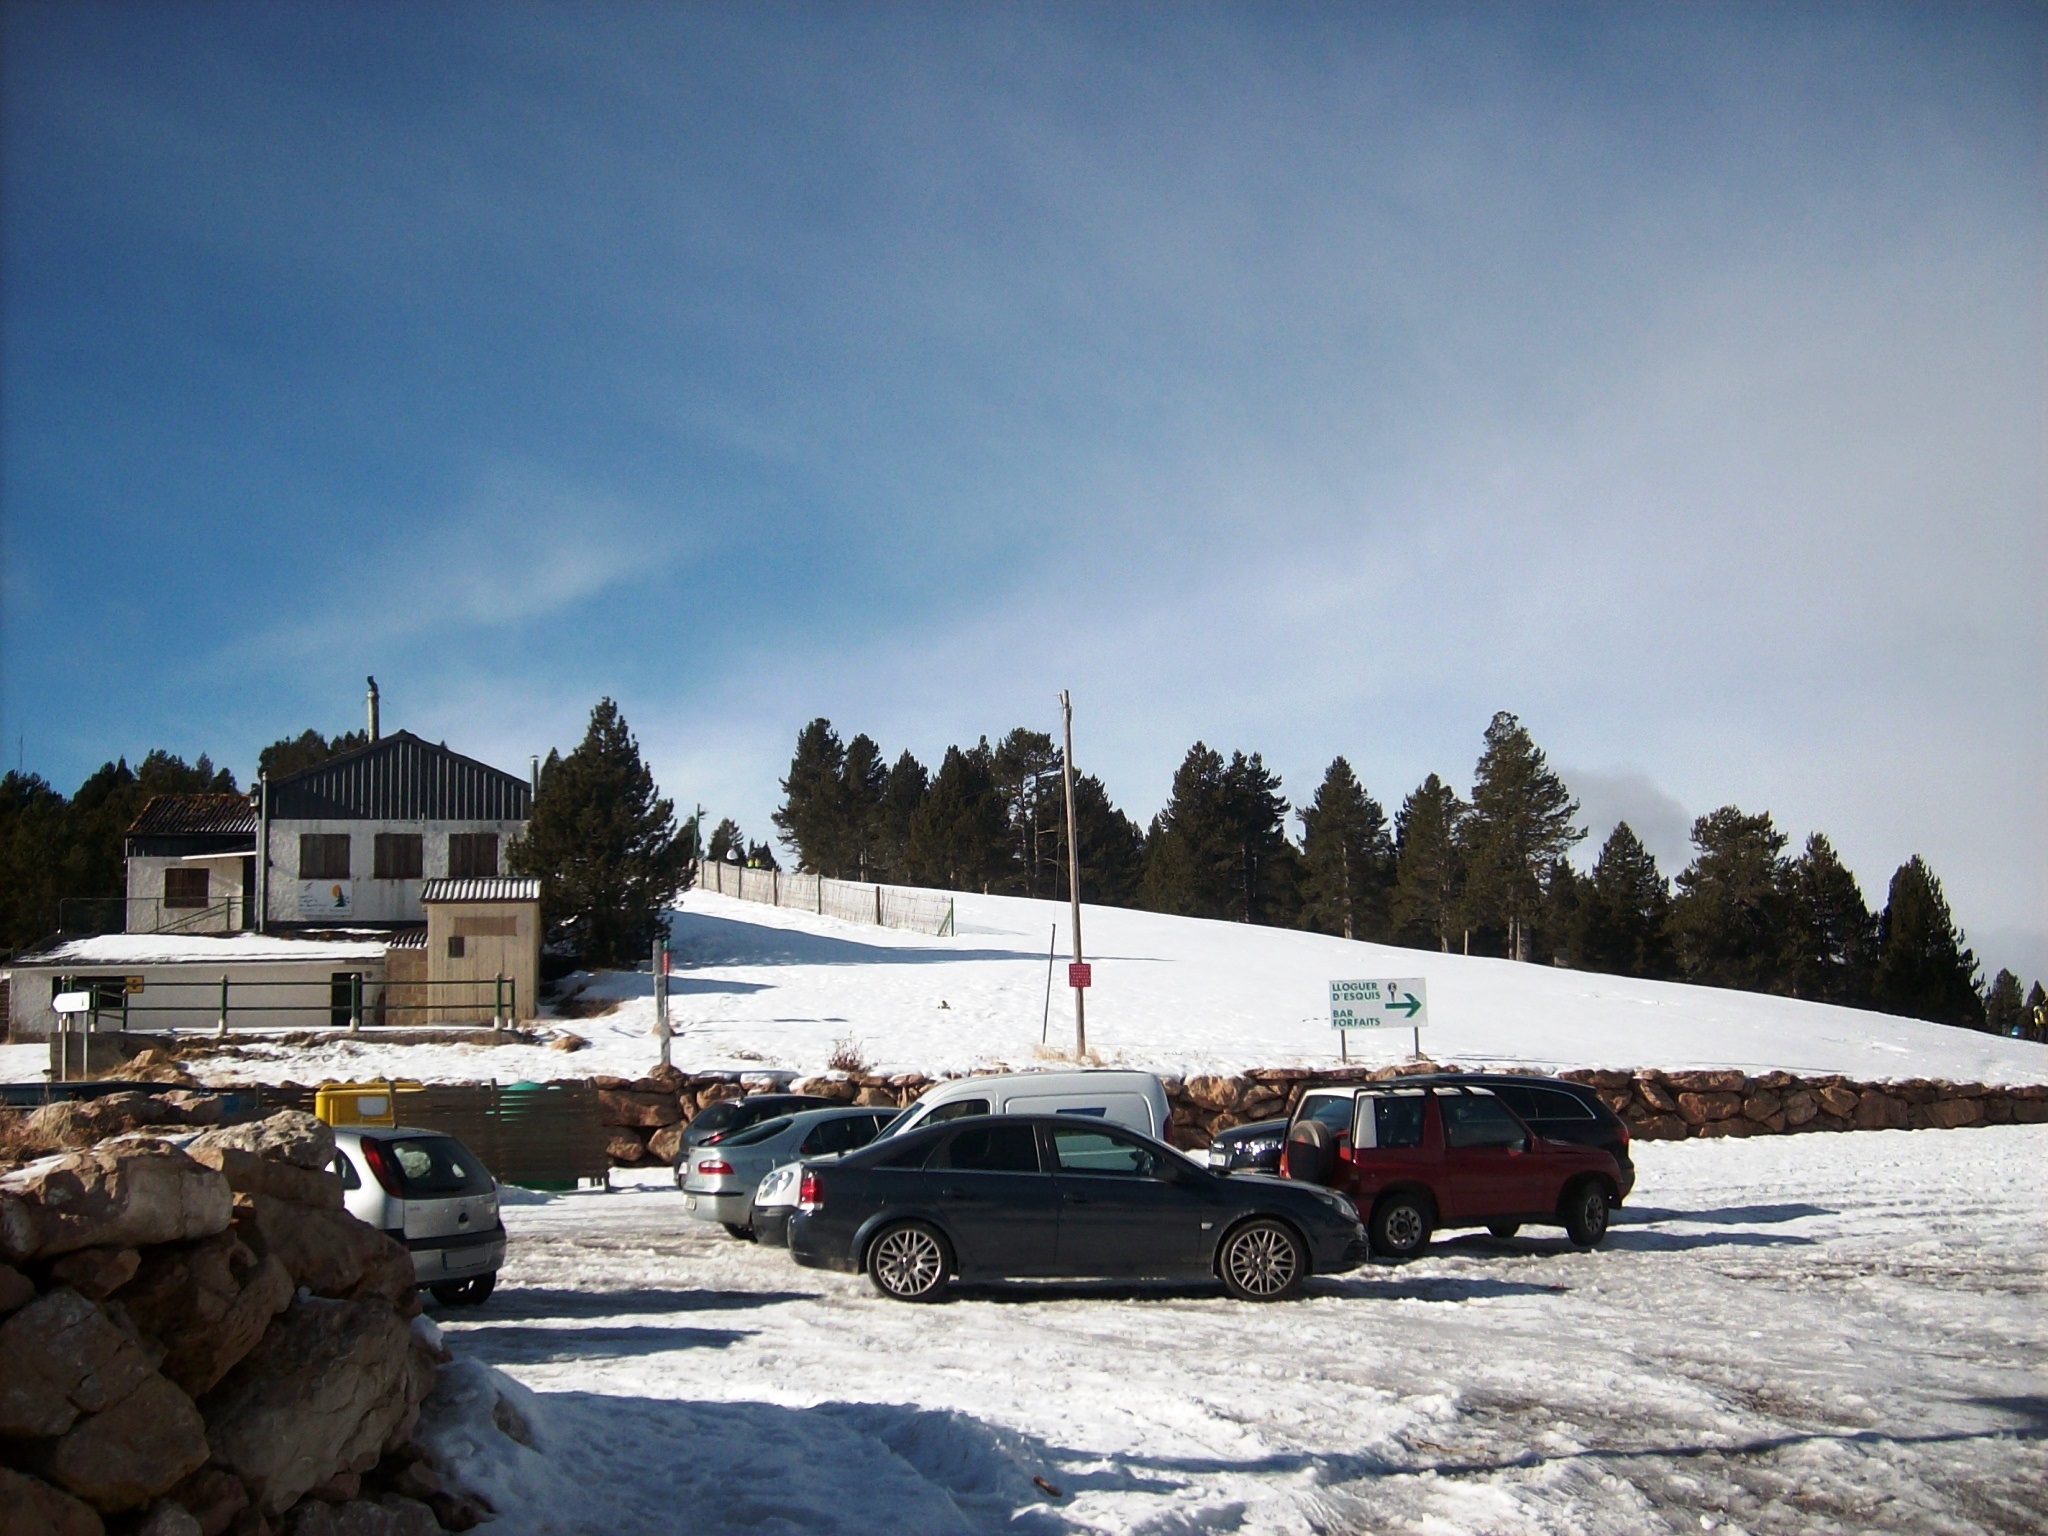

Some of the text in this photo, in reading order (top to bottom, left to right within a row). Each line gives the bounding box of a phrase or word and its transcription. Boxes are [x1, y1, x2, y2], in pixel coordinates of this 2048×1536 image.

[1332, 982, 1378, 992] LLOGUER
[1332, 991, 1381, 1001] D'ESQUIS
[1333, 1009, 1353, 1018] BAR
[1333, 1017, 1381, 1027] FORFAITS
